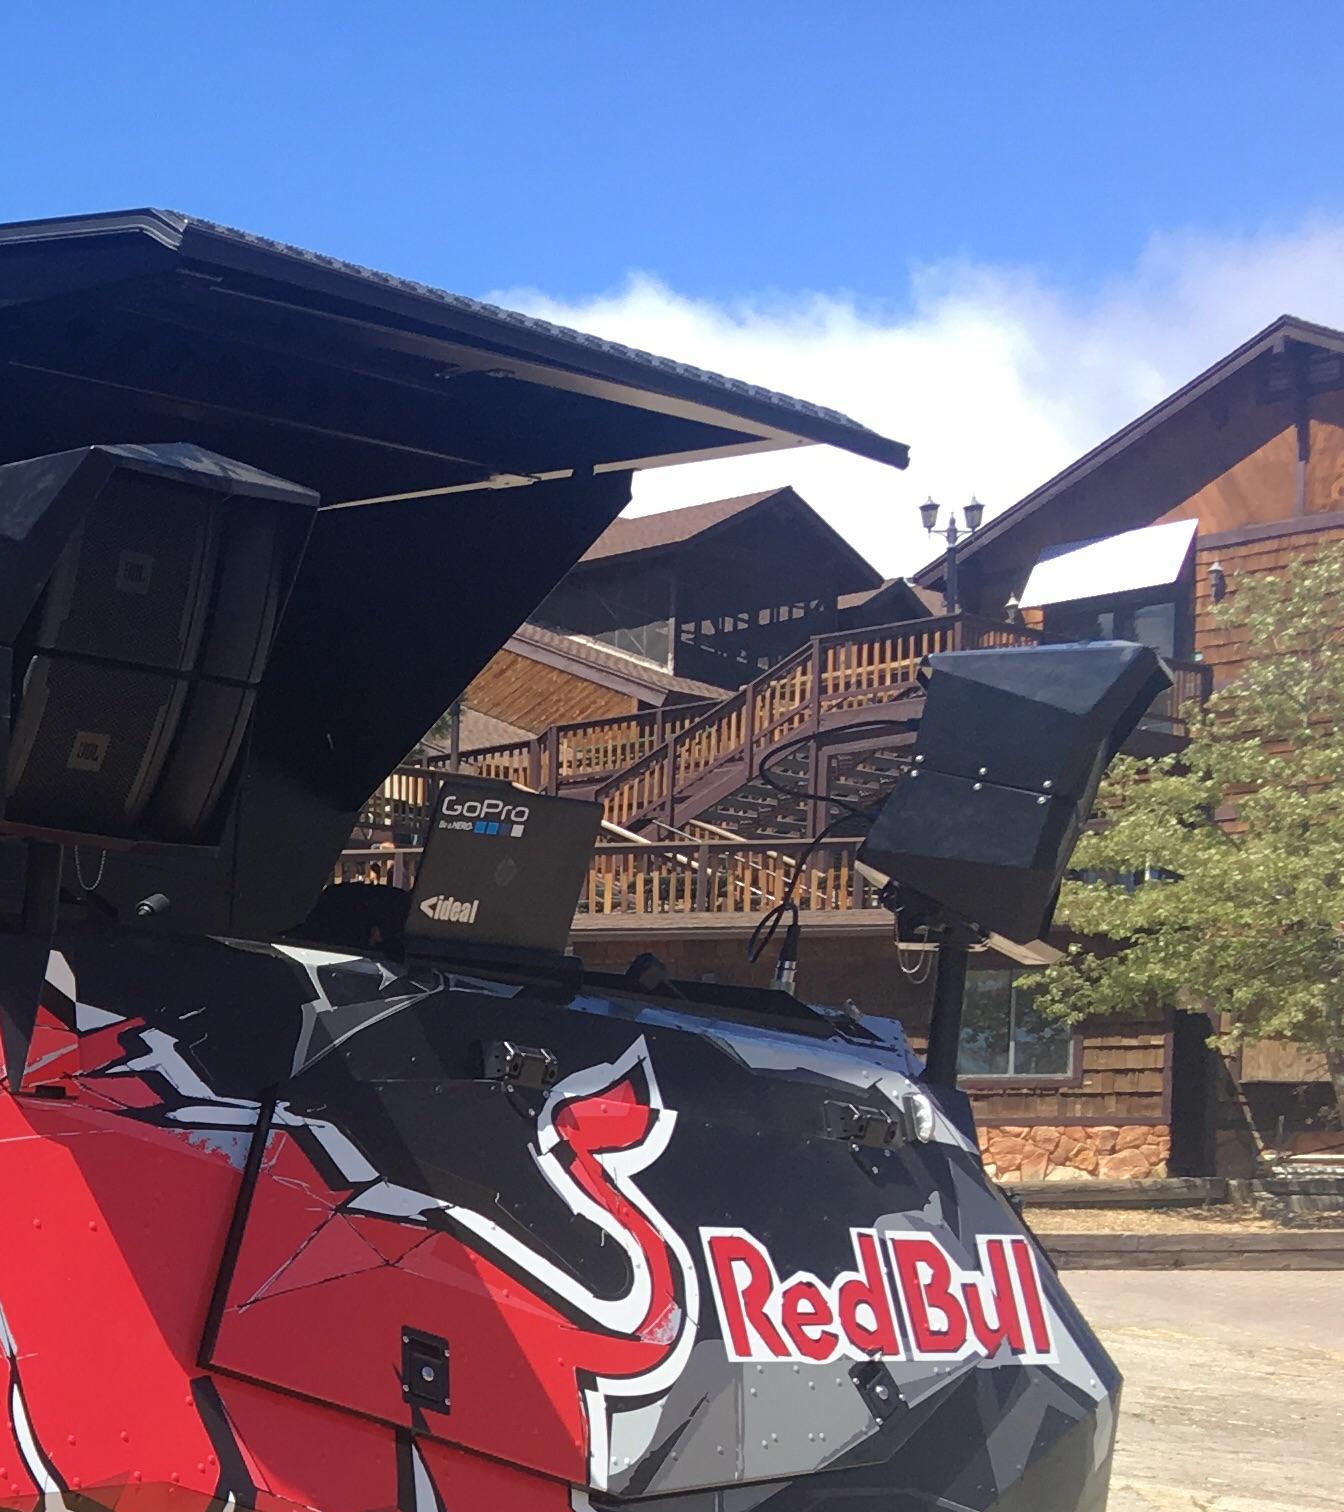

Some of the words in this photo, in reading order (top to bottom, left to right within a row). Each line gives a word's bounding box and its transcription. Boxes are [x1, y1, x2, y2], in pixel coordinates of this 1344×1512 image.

[441, 795, 531, 823] GoPro
[432, 894, 481, 925] ideal
[703, 1228, 903, 1362] Red
[888, 1232, 1056, 1362] Bull
